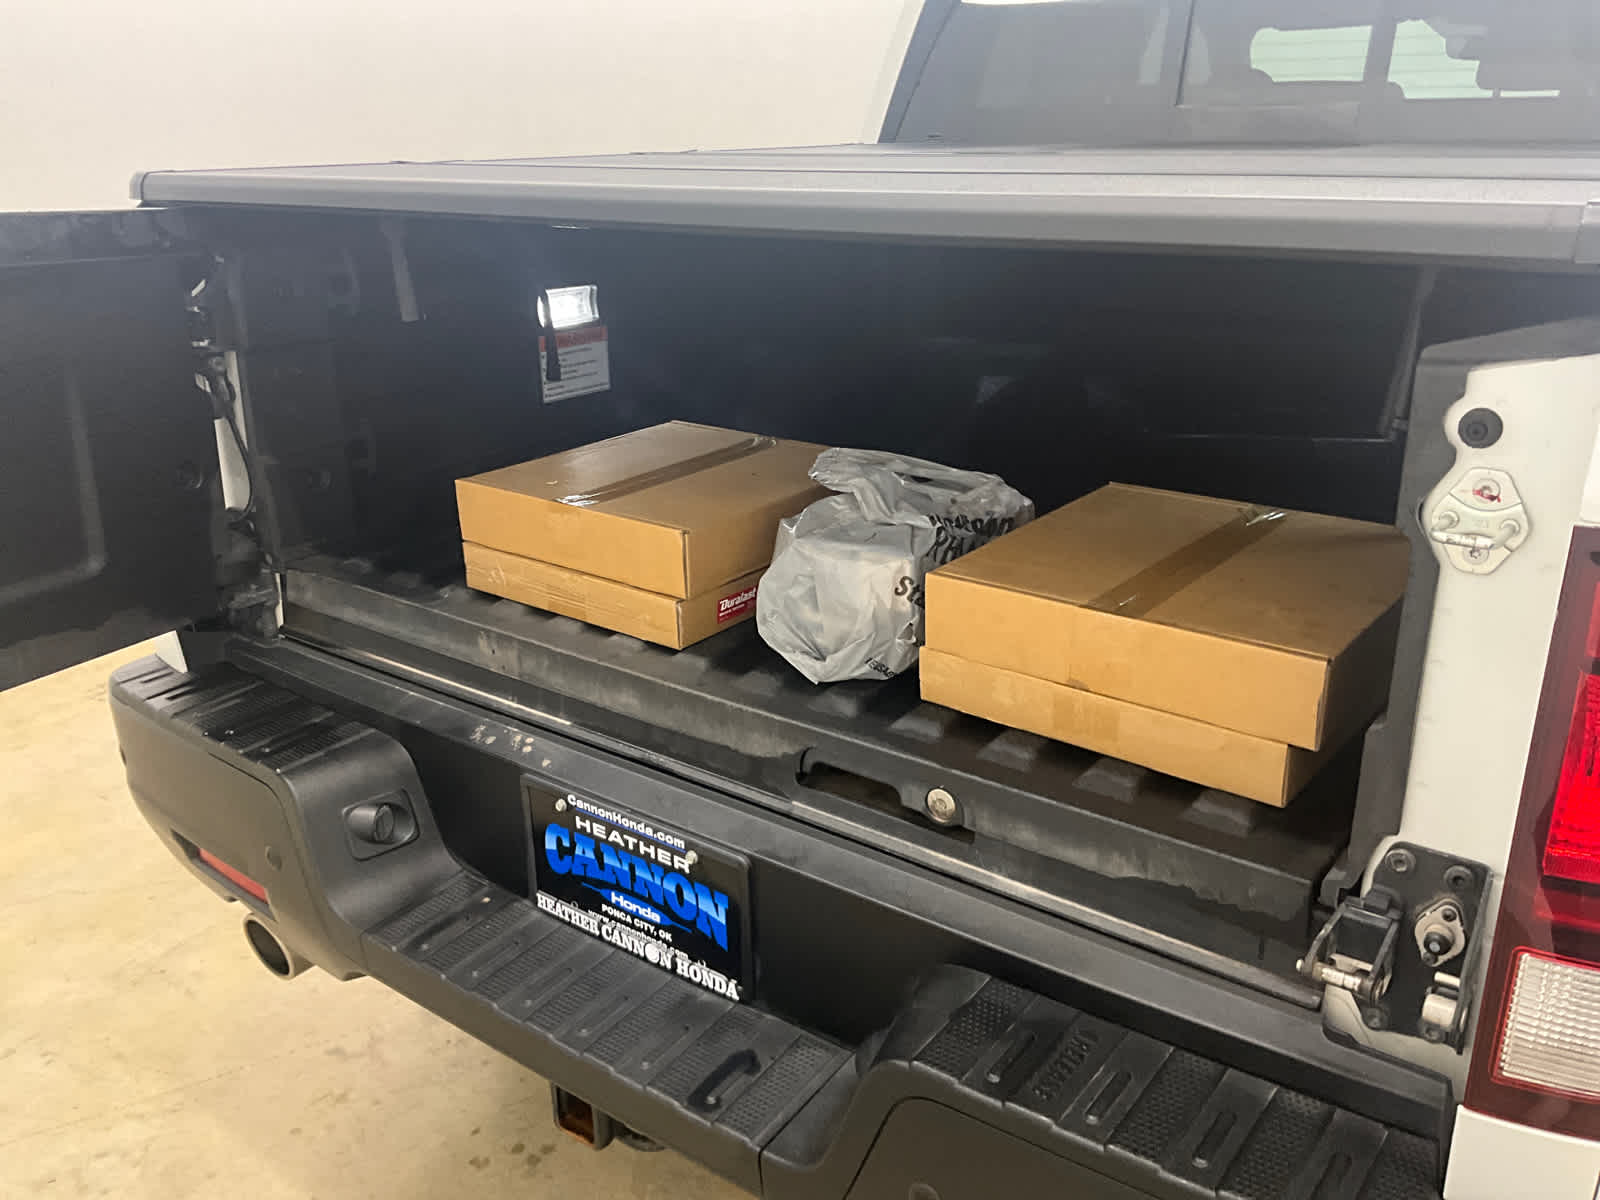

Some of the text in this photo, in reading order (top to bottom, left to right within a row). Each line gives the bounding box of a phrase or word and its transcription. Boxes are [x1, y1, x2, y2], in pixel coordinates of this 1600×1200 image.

[719, 587, 757, 611] Duralast
[567, 794, 685, 849] CannonHonda.com
[575, 815, 690, 874] HEATHER
[544, 823, 729, 952] CANNON
[611, 891, 661, 923] Honda
[536, 893, 740, 1001] HEATHER CANNON HONDA
[601, 903, 673, 942] PONCA CITY, OK
